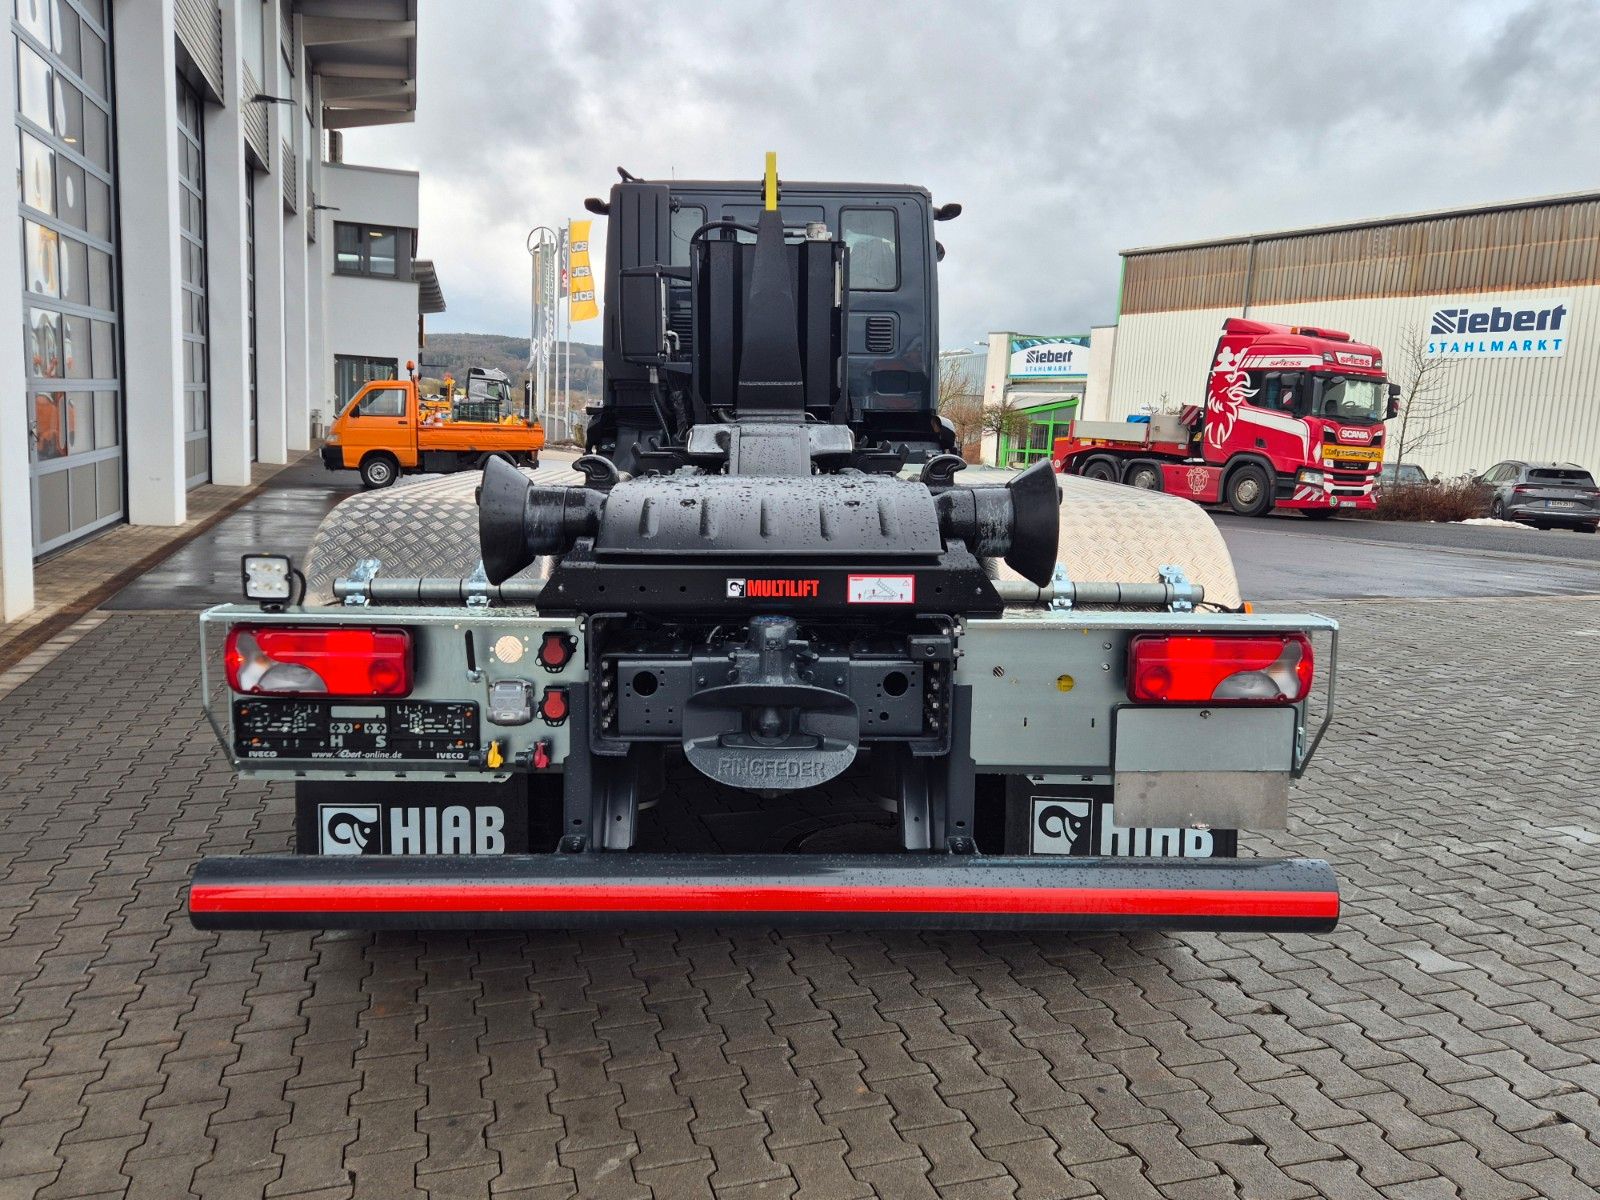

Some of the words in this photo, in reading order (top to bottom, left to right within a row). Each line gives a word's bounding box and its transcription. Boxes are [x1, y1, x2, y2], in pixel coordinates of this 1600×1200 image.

[571, 242, 588, 252] JCB
[571, 267, 591, 277] JCB
[571, 292, 594, 302] JCB
[1431, 304, 1567, 334] Siebert
[1428, 339, 1563, 353] STAHLMARKT
[1026, 349, 1073, 364] Siebert
[1340, 355, 1371, 367] SPIESS
[1269, 359, 1302, 367] SPIESS
[1341, 429, 1369, 439] SCANIA
[747, 579, 819, 597] MULTILIFT
[390, 805, 505, 855] HIAB
